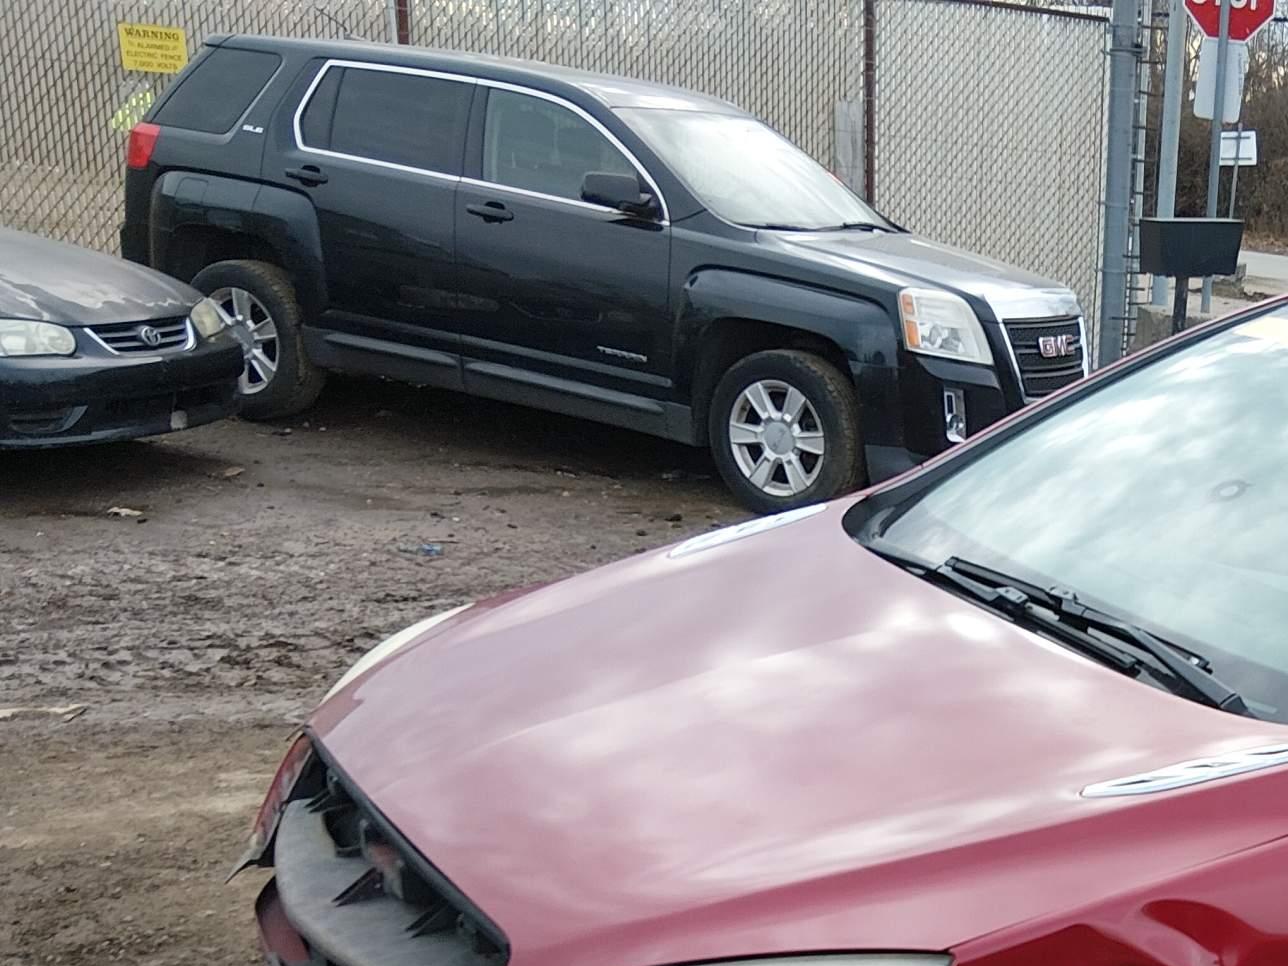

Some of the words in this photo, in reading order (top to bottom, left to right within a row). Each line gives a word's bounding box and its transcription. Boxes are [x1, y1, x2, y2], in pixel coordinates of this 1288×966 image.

[124, 27, 180, 41] WARNING
[160, 53, 183, 61] FENCE
[1039, 334, 1075, 358] GMC
